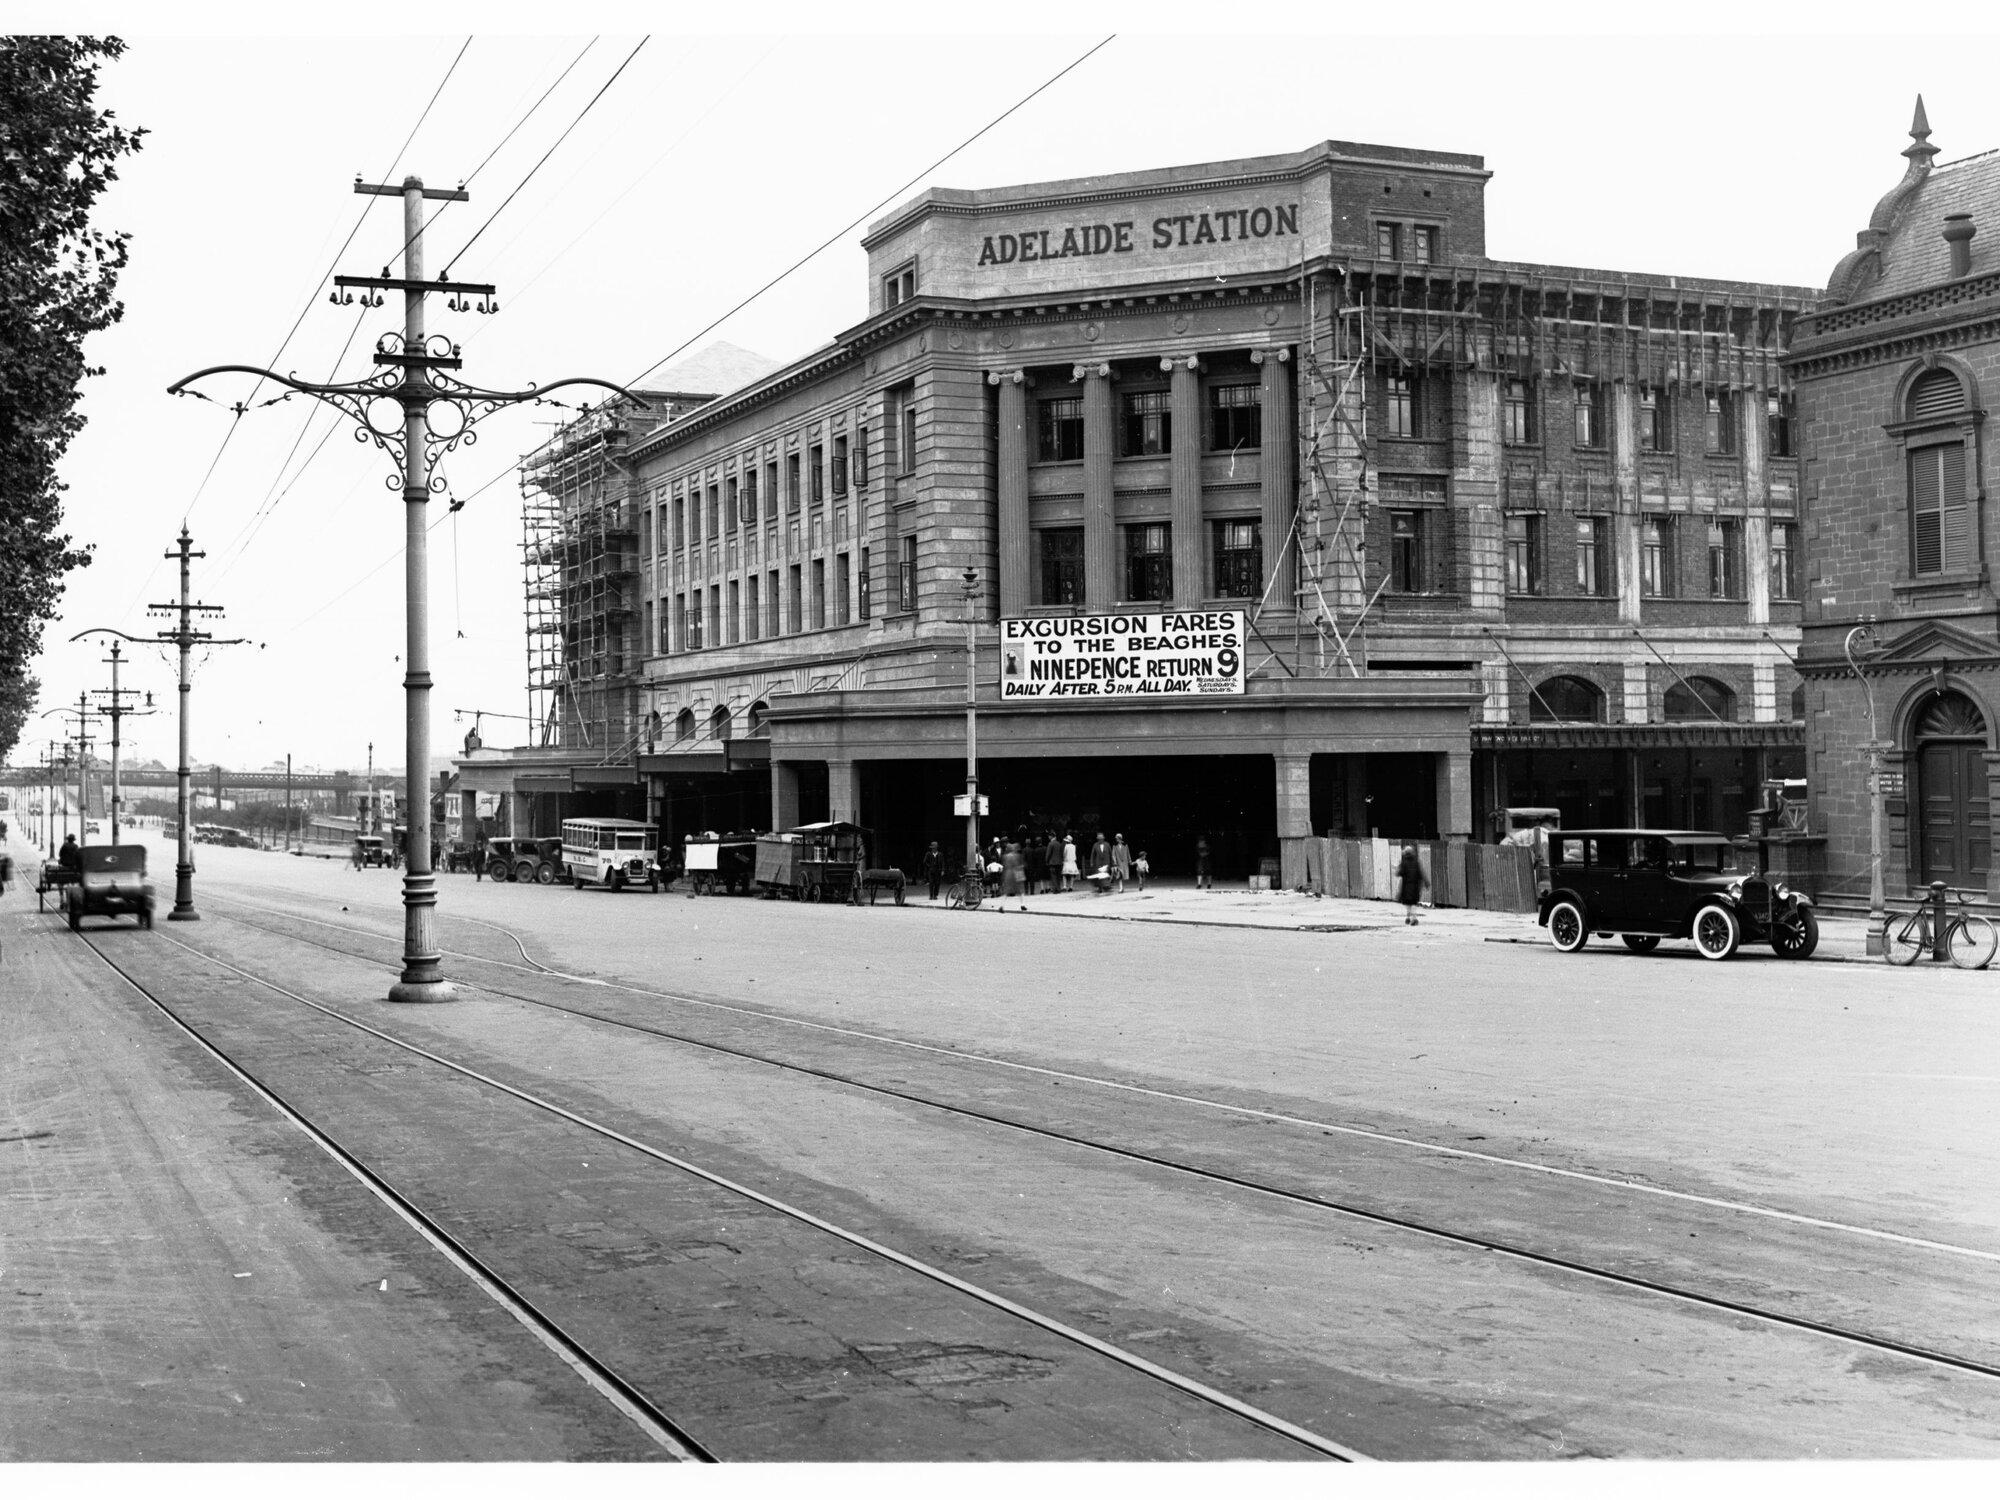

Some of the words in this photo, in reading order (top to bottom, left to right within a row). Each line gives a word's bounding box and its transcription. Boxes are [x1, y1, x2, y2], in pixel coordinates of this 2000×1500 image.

[977, 221, 1134, 267] ADELAIDE
[1152, 203, 1299, 249] STATION
[1161, 612, 1235, 633] FARES
[1033, 640, 1063, 655] TO
[1073, 637, 1115, 653] THE
[1030, 656, 1142, 681] NINEPENCE
[1146, 657, 1213, 678] RETURN
[1217, 648, 1240, 678] 9
[1005, 681, 1046, 696] DAILY
[1135, 678, 1162, 694] ALL
